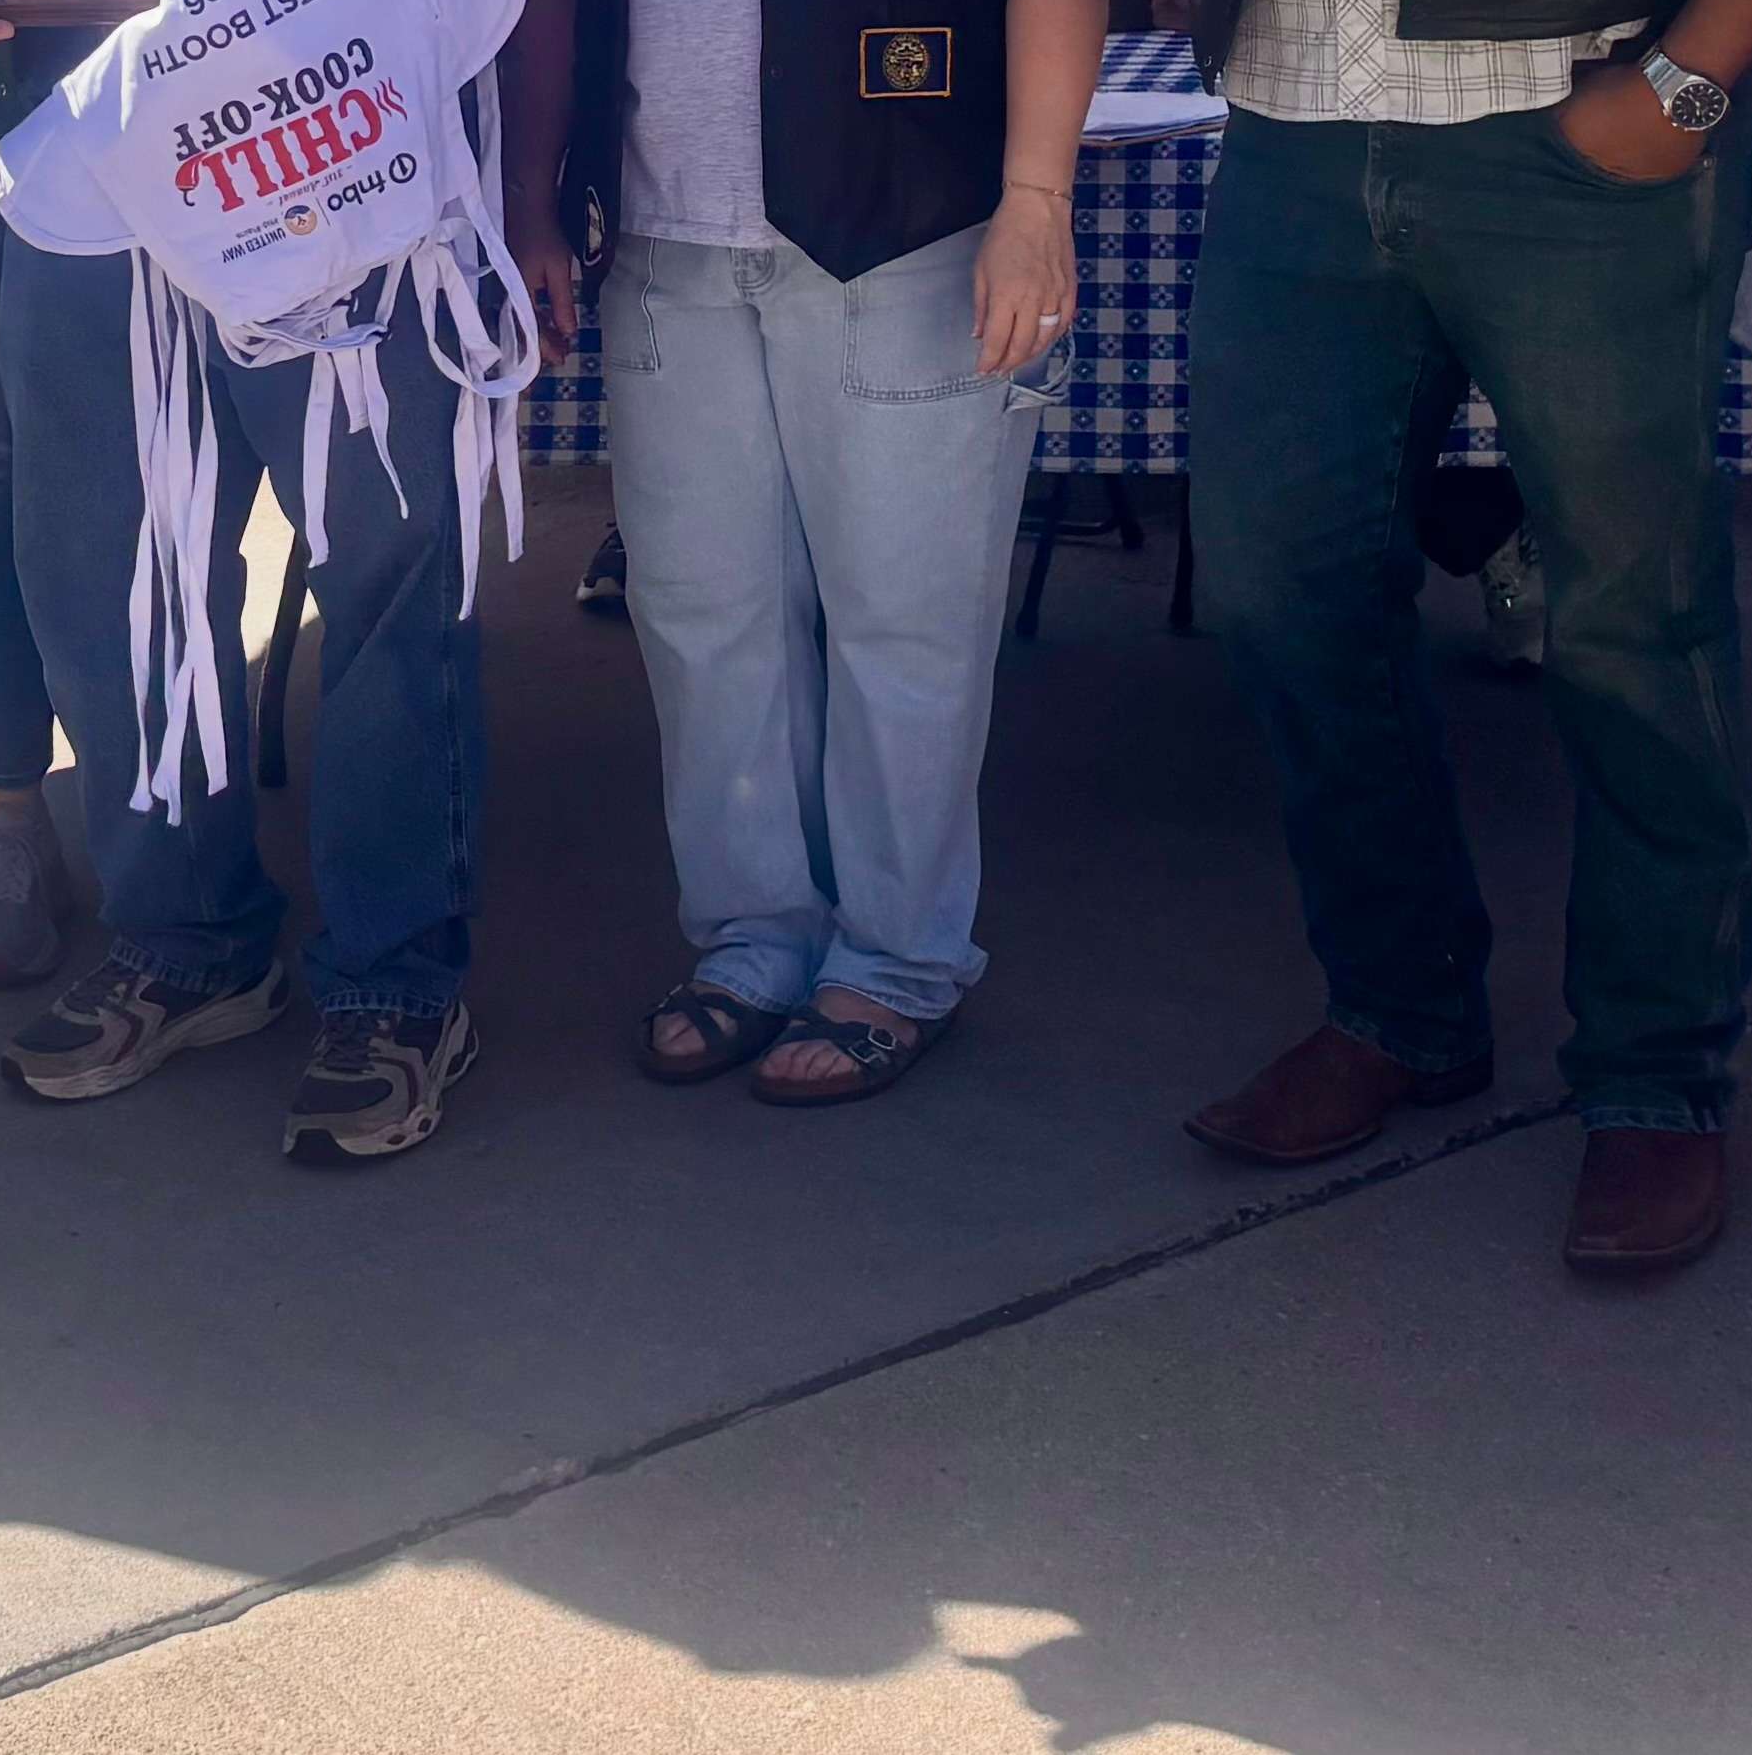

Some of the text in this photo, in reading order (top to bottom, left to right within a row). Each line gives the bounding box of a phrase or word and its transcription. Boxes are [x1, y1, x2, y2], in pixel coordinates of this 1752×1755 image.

[142, 8, 257, 79] BOOTH
[173, 37, 375, 162] COOK-OFF
[327, 169, 387, 212] fnbo
[221, 226, 287, 264] UNITED WAY
